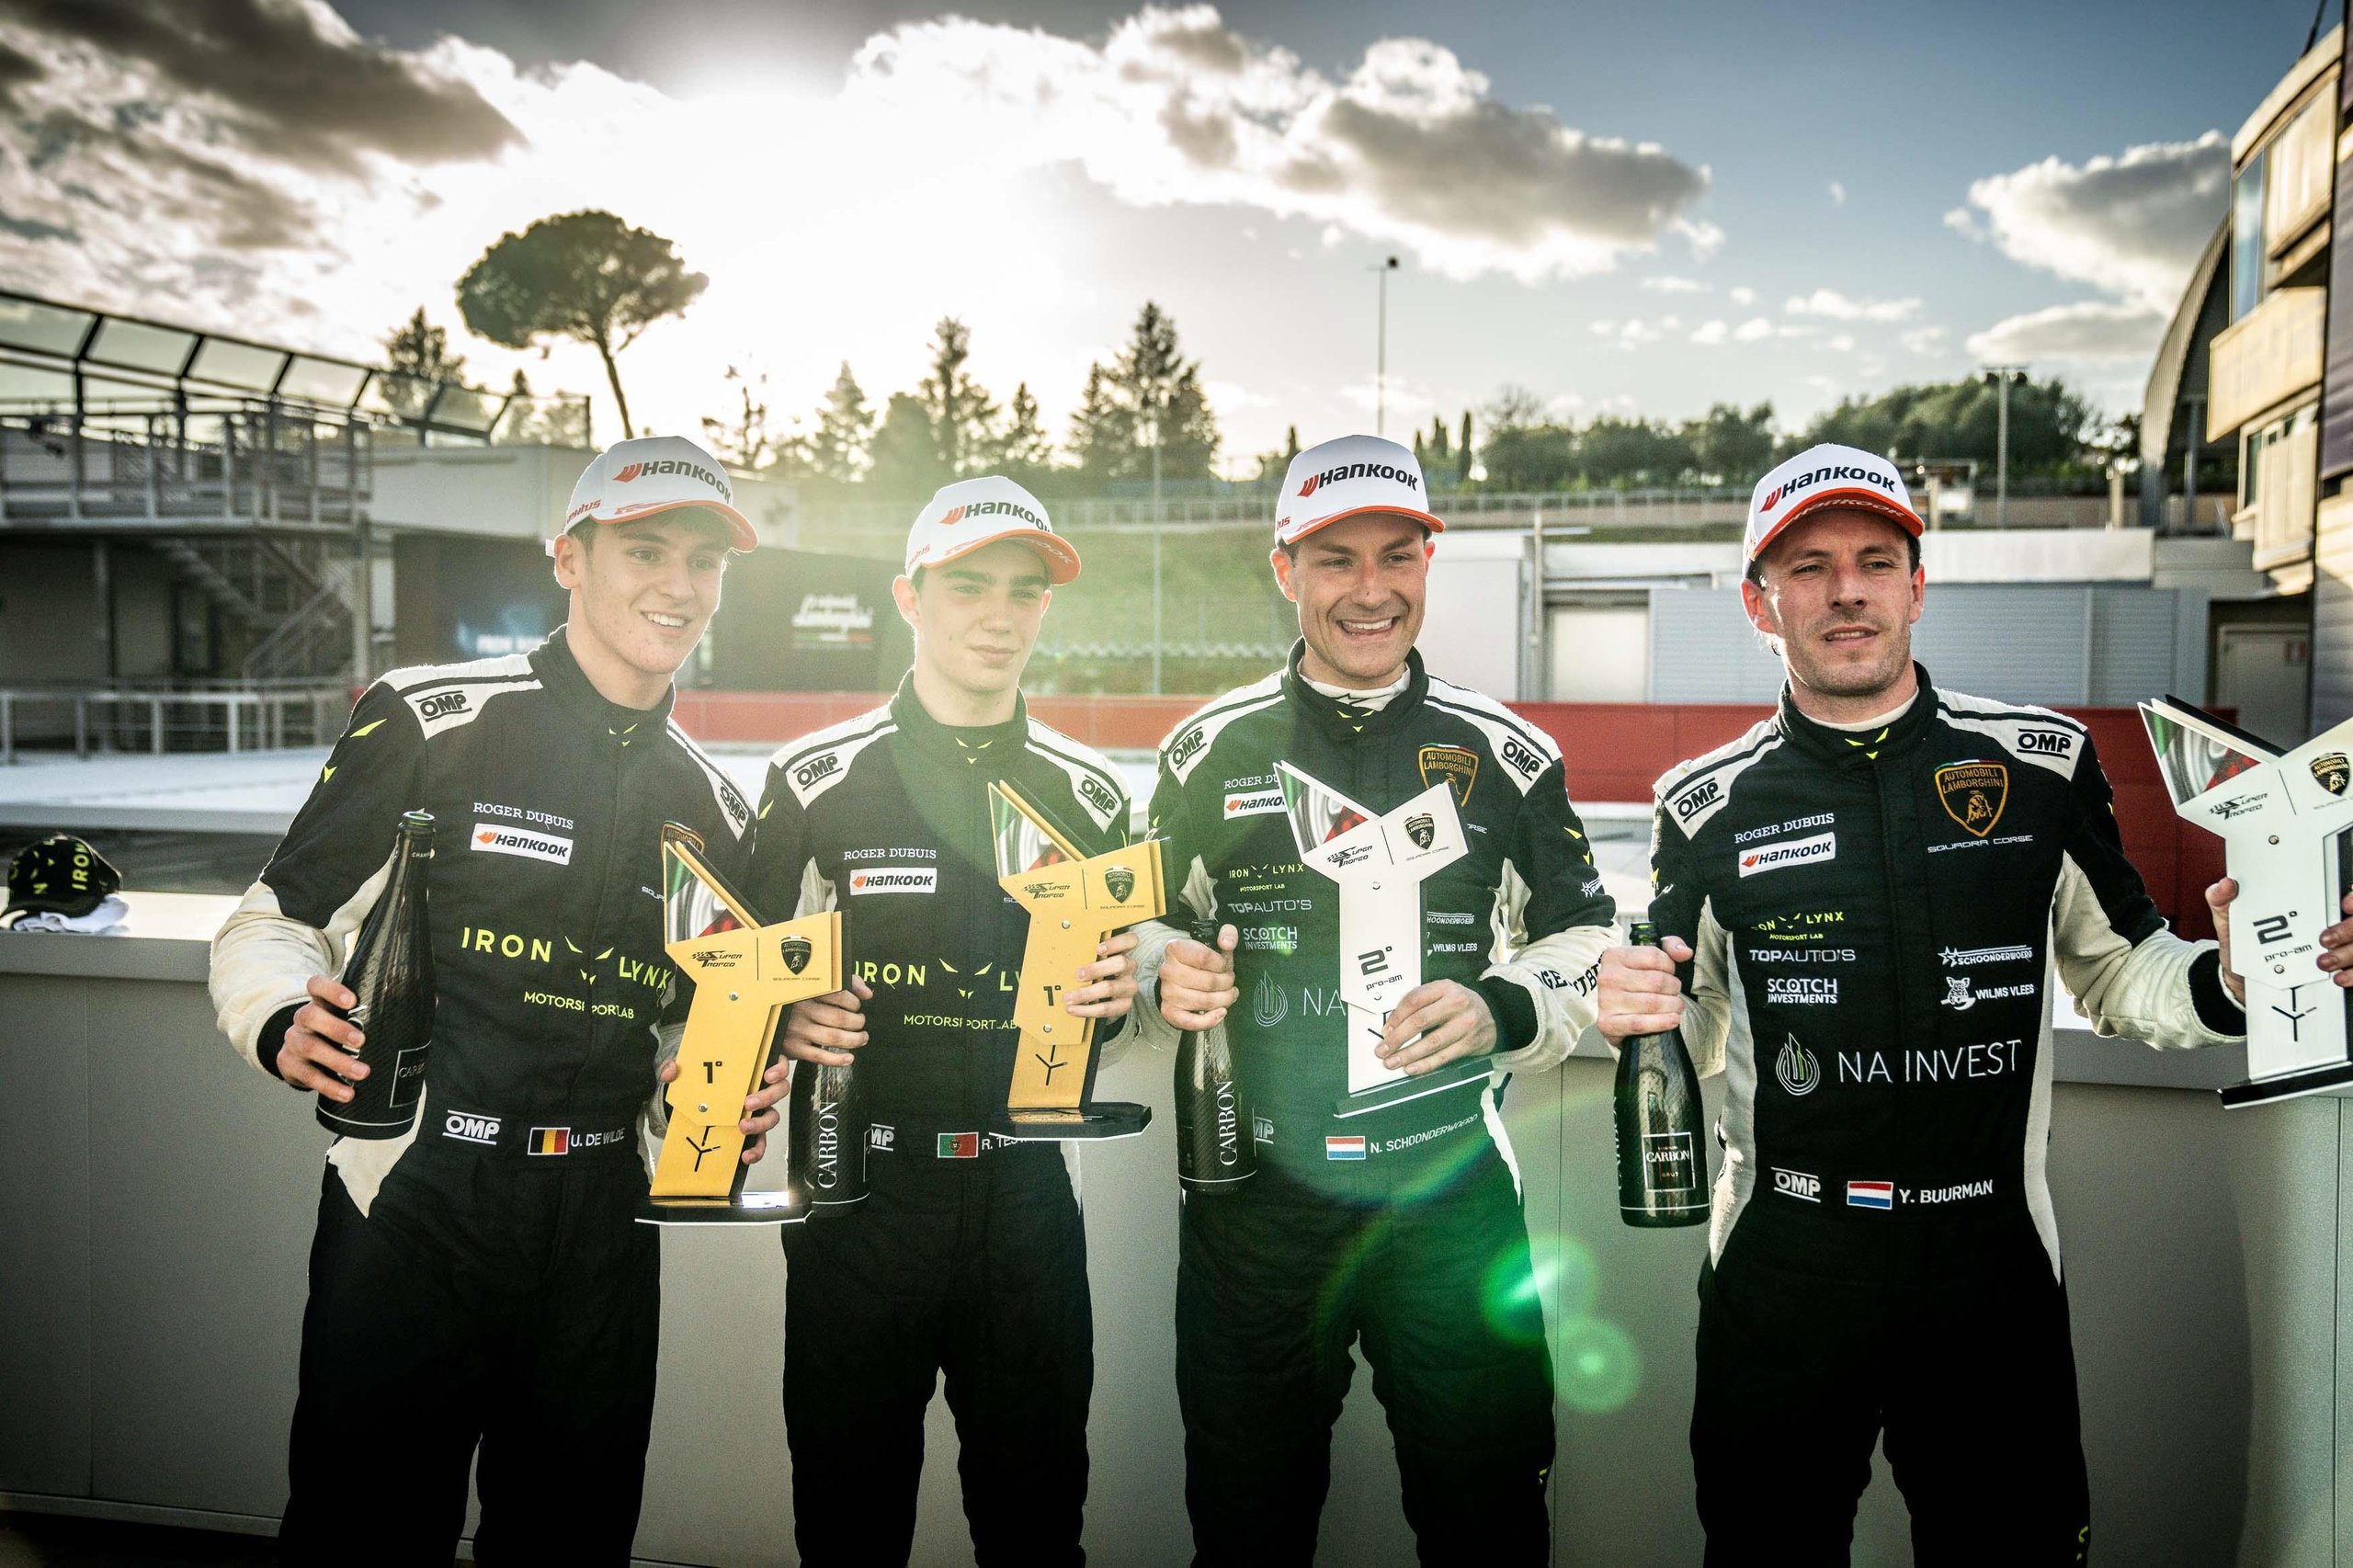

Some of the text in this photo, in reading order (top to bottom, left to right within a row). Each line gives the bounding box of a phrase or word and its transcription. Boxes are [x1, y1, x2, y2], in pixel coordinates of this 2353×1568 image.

[419, 694, 466, 717] OMP
[1172, 731, 1204, 766] OMP
[2018, 733, 2071, 753] OMP
[1427, 752, 1471, 767] AUTOMOBILI
[1504, 742, 1540, 773] OMP
[797, 756, 837, 785] OMP
[1425, 762, 1472, 776] LAMBORGHINI
[1944, 768, 1998, 782] AUTOMOBILI
[1224, 776, 1263, 790] ROGER
[1942, 778, 2004, 794] LAMBORGHINI
[720, 786, 747, 822] OMP
[1081, 778, 1117, 812] OMP
[1677, 782, 1719, 817] OMP
[473, 802, 574, 829] ROGER DUBUIS
[1734, 812, 1835, 844] ROGER DUBUIS
[1927, 835, 2034, 853] SQUADRA CORSE
[844, 847, 937, 860] ROGER DUBUIS
[1229, 864, 1304, 879] IRON LYNX
[1228, 900, 1312, 913] TOPAUTO'S
[1806, 911, 1844, 924] LYNX
[1243, 926, 1297, 940] SCOTCH
[1245, 941, 1298, 950] INVESTMENTS
[1433, 943, 1478, 952] WILMS VLEES
[2264, 944, 2313, 962] pro-am
[461, 926, 672, 989] IRON LYNX
[1749, 949, 1856, 962] TOPAUTO'S
[1958, 950, 2032, 965] SCHOONDERWOERD
[855, 960, 926, 986] IRON
[1366, 974, 1403, 991] pro-am
[1768, 978, 1838, 994] SCOTCH
[1975, 983, 2035, 999] WILMS VLEES
[1303, 987, 1347, 1017] NA
[1768, 993, 1838, 1005] INVESTMENTS
[1839, 1040, 2021, 1083] NA INVEST
[446, 1116, 499, 1140] OMP
[1217, 1081, 1237, 1165] CARBON
[571, 1128, 625, 1148] U. DE WILDE
[871, 1128, 894, 1146] MP
[1370, 1114, 1478, 1153] N. SCHOONDERWOERD
[818, 1102, 838, 1188] CARBON
[982, 1139, 993, 1150] R.
[1646, 1150, 1689, 1163] CARBON
[1776, 1172, 1821, 1197] OMP
[1899, 1179, 1994, 1204] Y. BUURMAN
